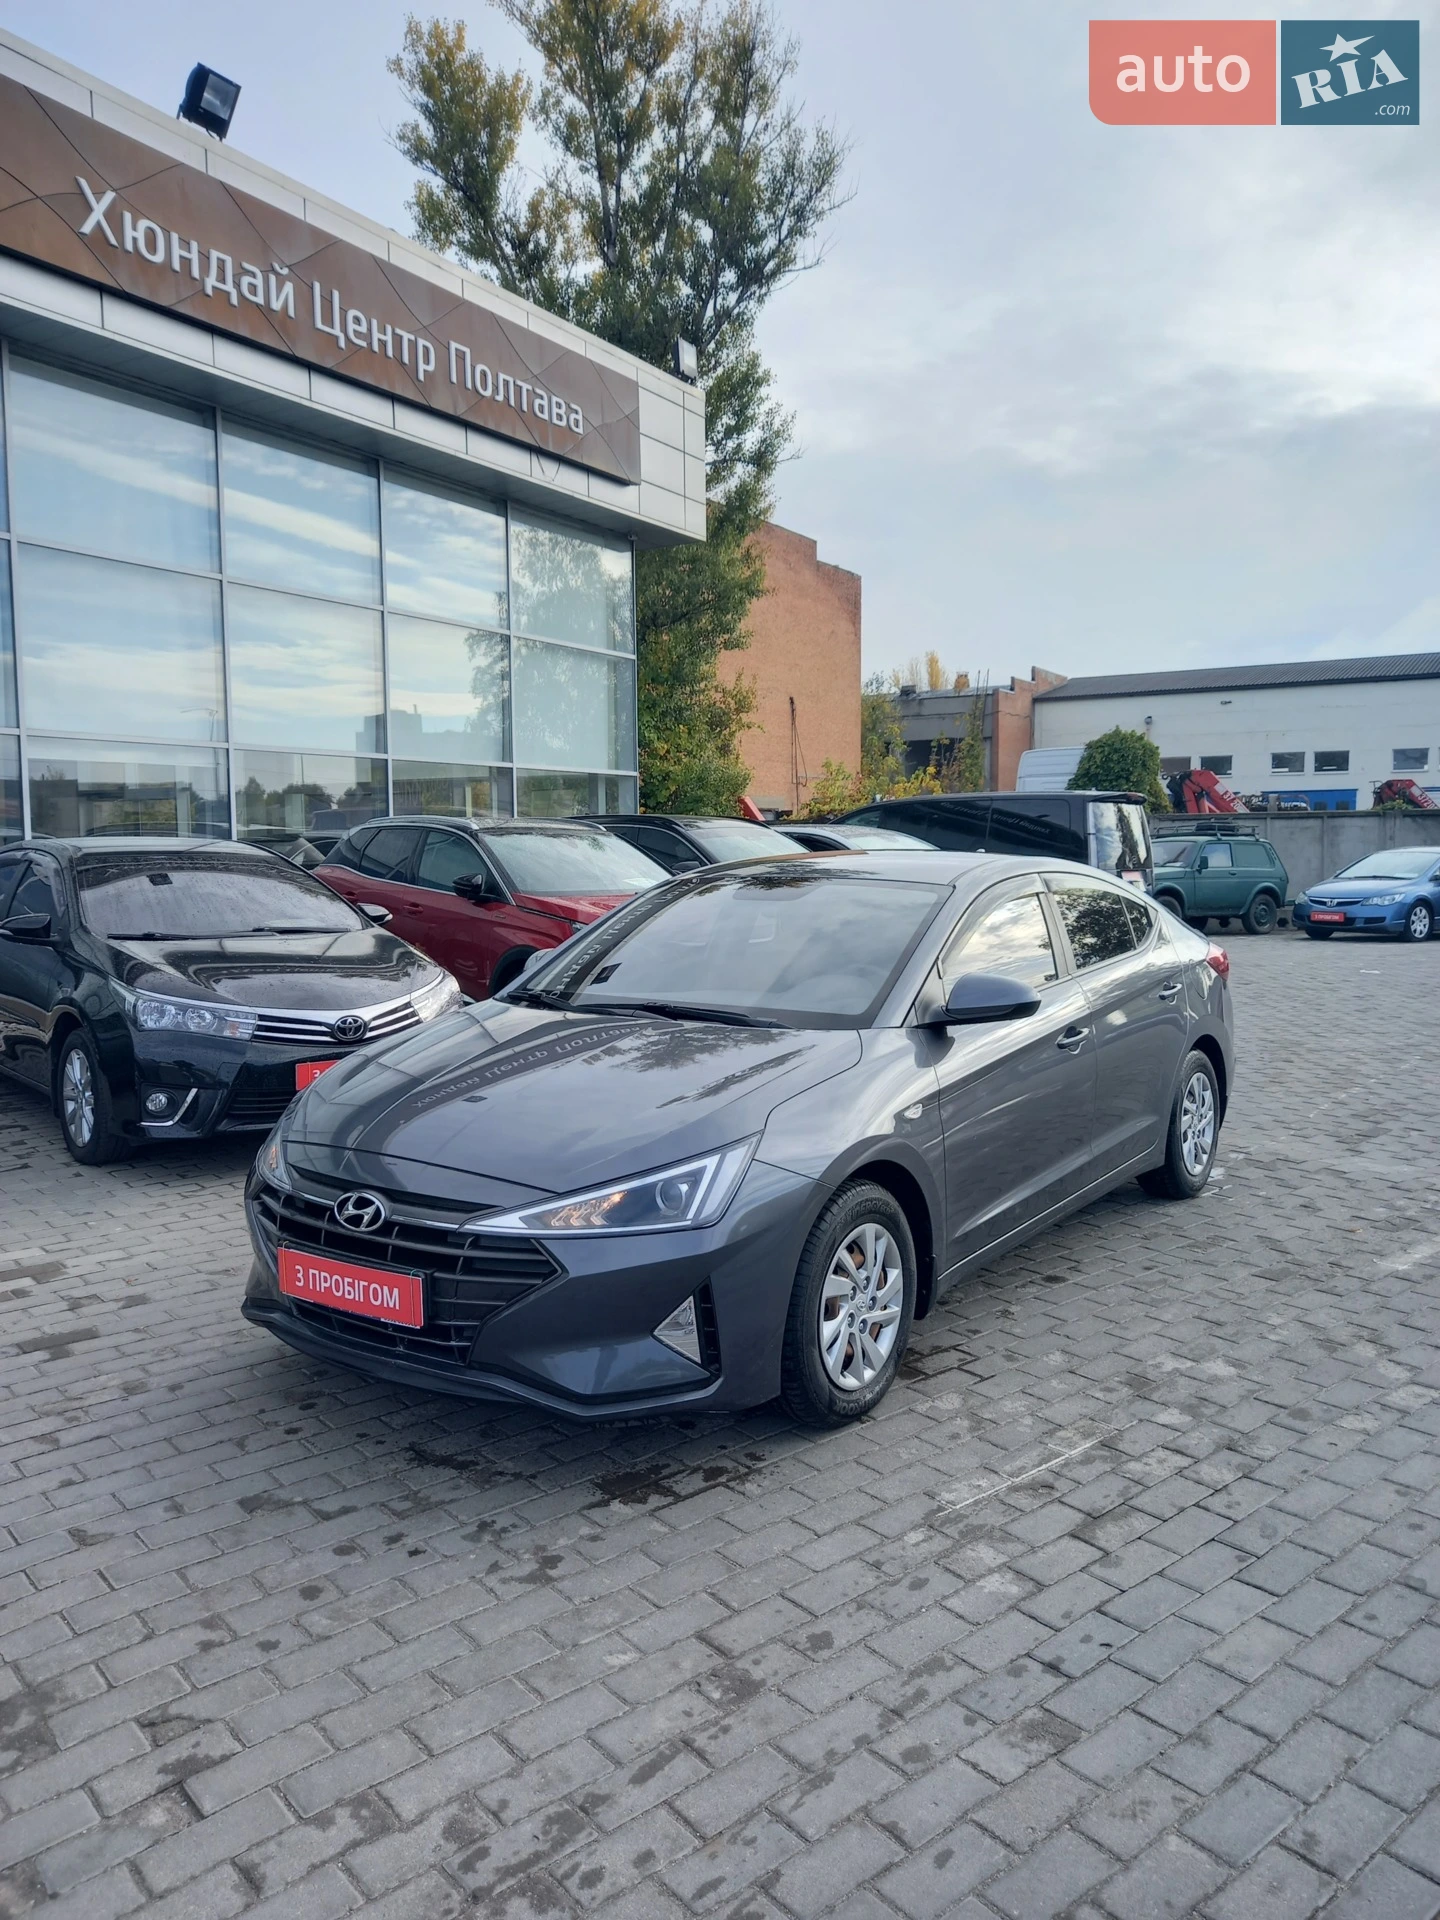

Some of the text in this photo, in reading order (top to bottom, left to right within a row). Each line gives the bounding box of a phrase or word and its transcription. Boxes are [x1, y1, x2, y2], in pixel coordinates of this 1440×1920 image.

[75, 175, 585, 436] Хюндай Центр Полтава
[294, 1265, 400, 1310] З ПРОБІГОМ
